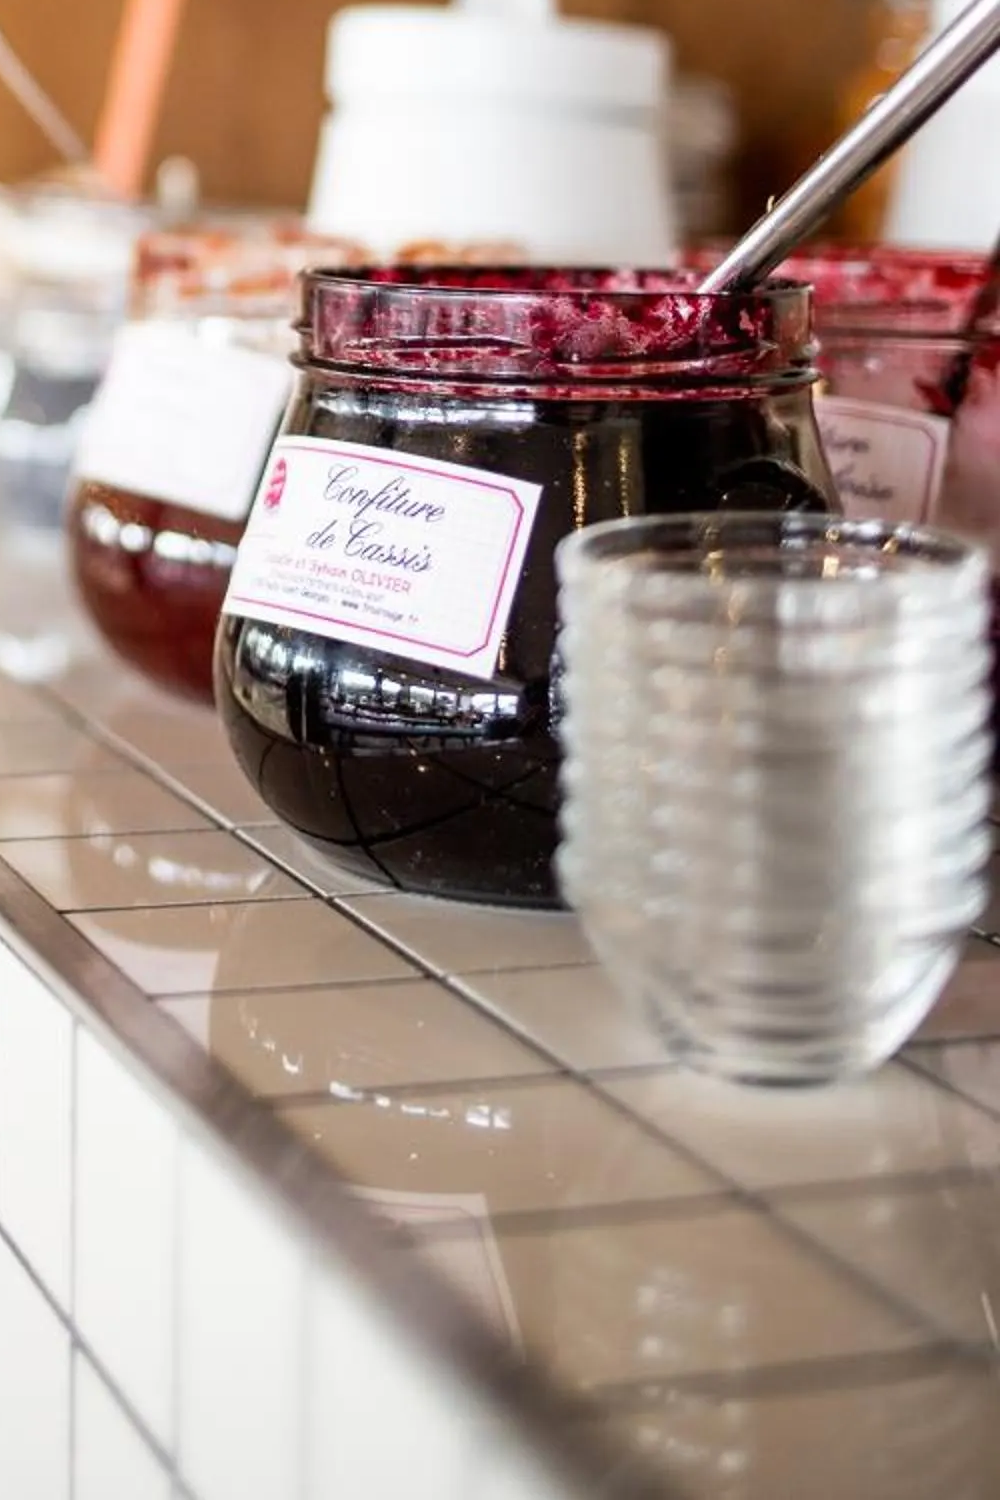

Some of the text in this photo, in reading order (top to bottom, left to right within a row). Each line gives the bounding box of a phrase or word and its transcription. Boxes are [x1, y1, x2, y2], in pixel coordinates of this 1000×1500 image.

[323, 463, 446, 523] Confiture
[305, 518, 434, 573] de Cassis
[351, 568, 412, 596] OLIVIER
